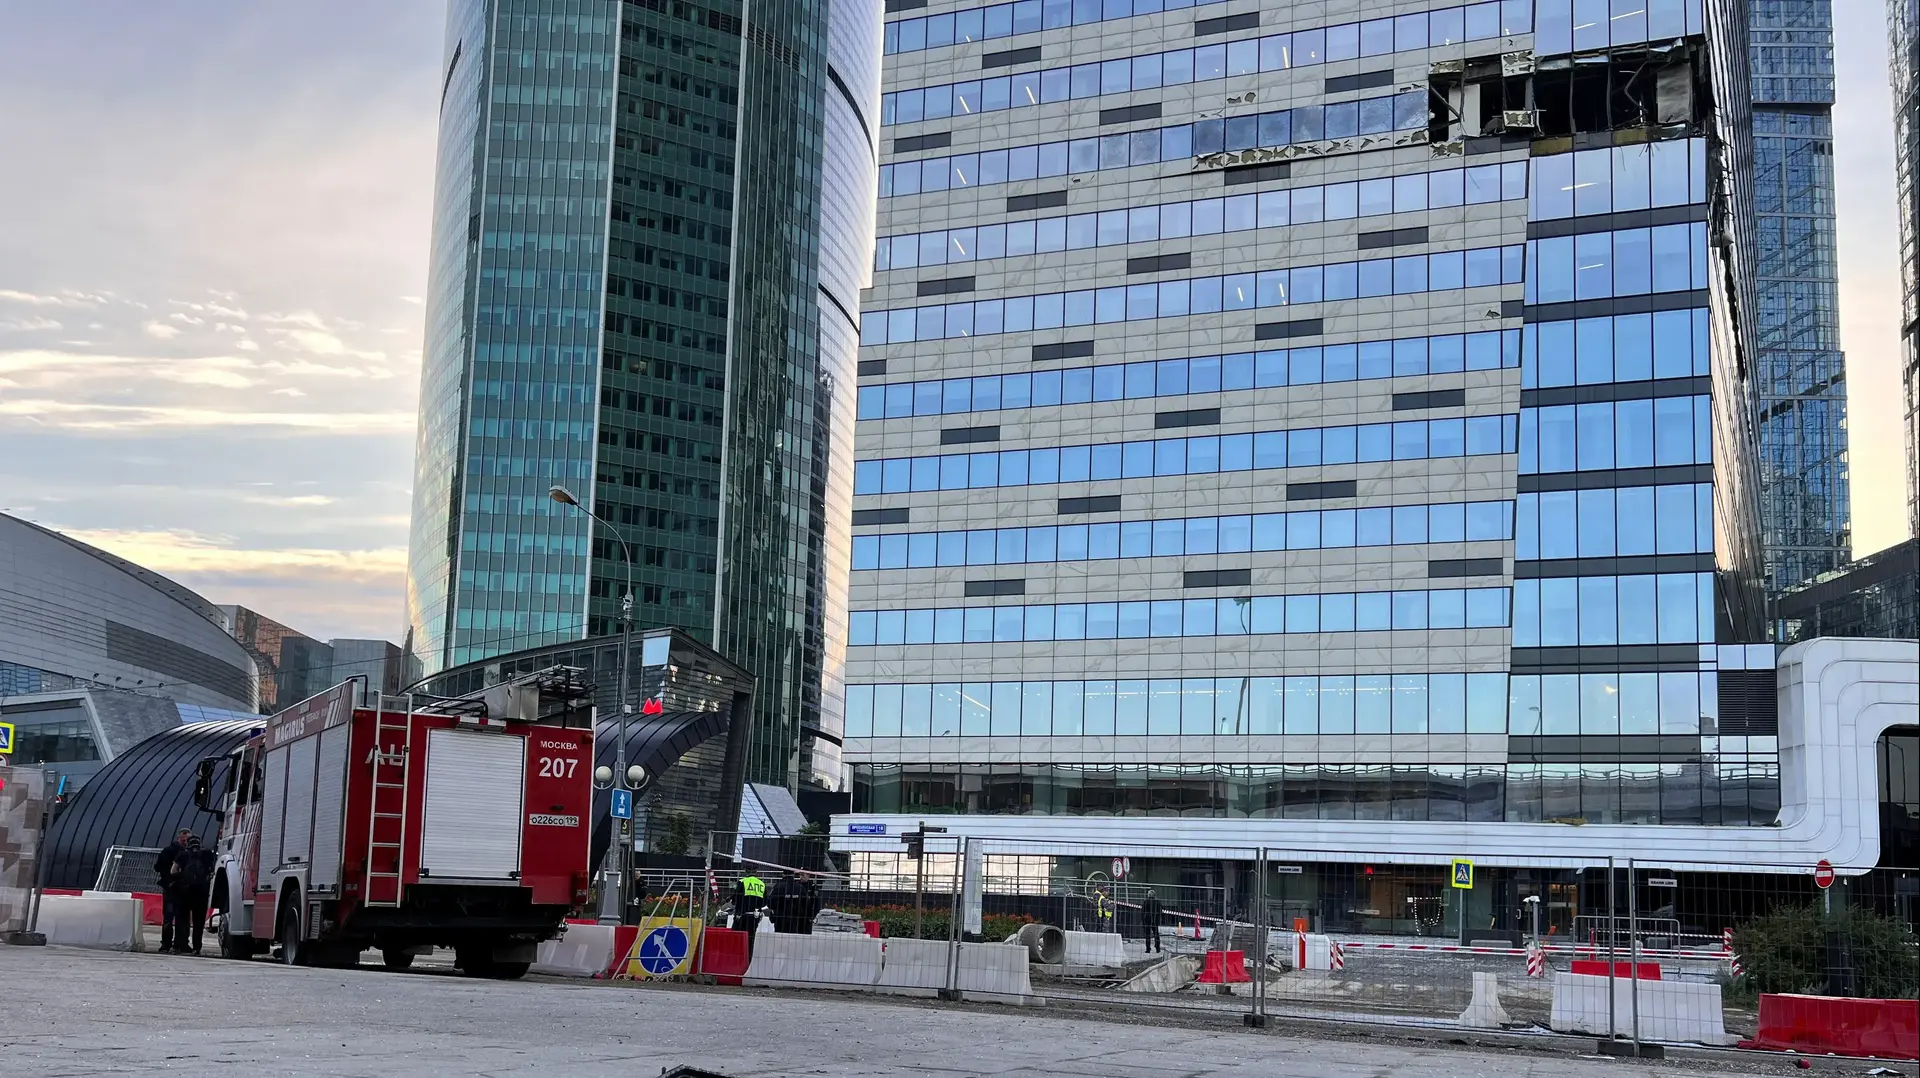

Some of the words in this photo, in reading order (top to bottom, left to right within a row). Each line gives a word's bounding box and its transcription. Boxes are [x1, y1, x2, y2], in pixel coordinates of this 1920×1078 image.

[274, 716, 306, 745] MAGIRUS
[540, 740, 578, 750] МОСКВА
[538, 756, 579, 779] 207
[747, 882, 764, 894] ДПС
